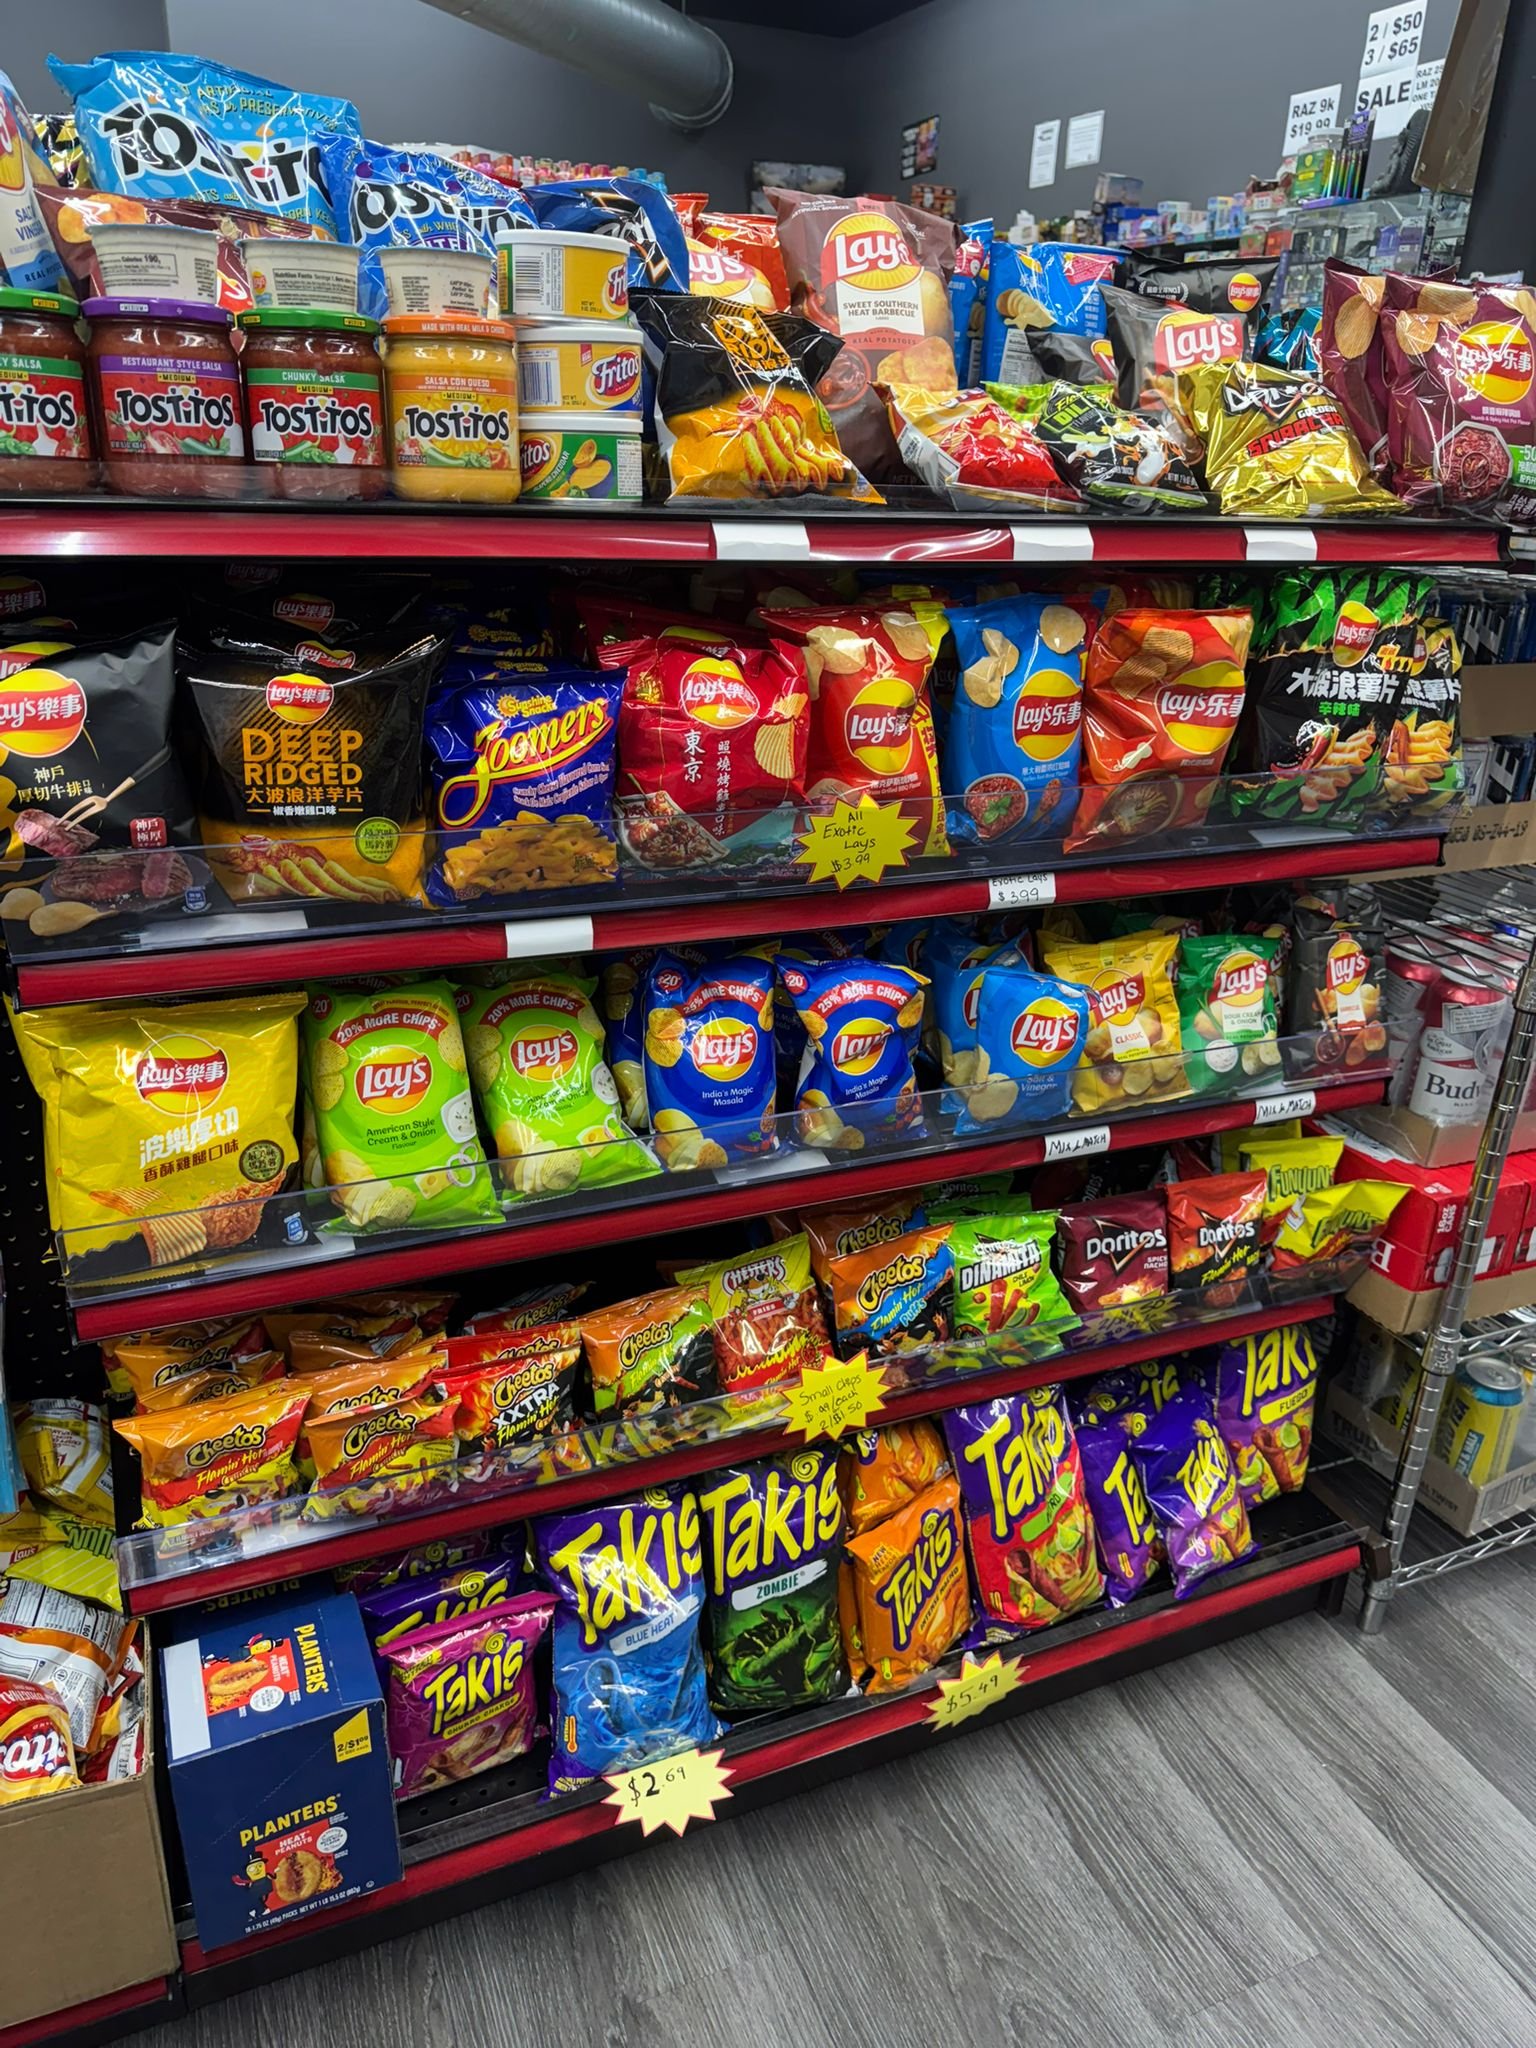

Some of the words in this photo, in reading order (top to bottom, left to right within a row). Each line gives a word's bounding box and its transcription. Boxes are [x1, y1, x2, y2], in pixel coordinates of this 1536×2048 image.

[1369, 24, 1379, 42] 2
[1392, 11, 1423, 36] $50
[1364, 49, 1374, 66] 3
[1387, 36, 1419, 61] $65
[1416, 68, 1433, 79] RAZ
[1357, 79, 1412, 113] SALE
[1412, 92, 1429, 103] ONE
[1292, 101, 1316, 119] RAZ
[1289, 117, 1331, 138] $1999
[834, 232, 913, 278] Lay's
[25, 269, 46, 282] REAL
[843, 300, 872, 310] SWEET
[874, 299, 919, 310] SOUTHERN
[848, 308, 870, 317] HEAT
[872, 307, 916, 318] BARBECUE
[1164, 318, 1242, 370] Lay's
[11, 356, 42, 370] SALSA
[122, 356, 174, 368] RESTAURANT
[176, 359, 201, 370] STYLE
[202, 361, 222, 372] SALSA
[591, 353, 639, 395] Fritos
[1501, 351, 1532, 373] 乐事
[161, 373, 194, 383] MEDIUM
[281, 371, 317, 383] CHUNKY
[319, 373, 346, 385] SALSA
[301, 386, 329, 394] MEDIUM
[425, 376, 449, 386] SALSA
[450, 377, 467, 386] CON
[468, 378, 490, 388] QUESO
[114, 385, 235, 428] TOSTITOS
[446, 392, 474, 400] MEDIUM
[260, 396, 373, 437] TOSTITOS
[405, 404, 510, 441] TOSTITOS
[1297, 404, 1337, 419] GOLDEN
[276, 600, 304, 620] Lay's
[304, 604, 332, 619] 樂事
[1336, 619, 1359, 646] Lay's
[269, 684, 302, 705] Lay's
[302, 687, 333, 704] 樂事
[685, 677, 724, 703] Lay's
[1285, 667, 1400, 704] 大波浪薯片
[37, 693, 83, 719] 樂事
[507, 694, 554, 713] Sunshine
[520, 702, 558, 719] Snacks
[1016, 703, 1051, 734] Lay's
[1050, 700, 1083, 727] 乐事
[1161, 691, 1206, 721] Lay's
[1206, 692, 1247, 718] 乐事
[1318, 701, 1361, 717] 辛辣味
[849, 711, 896, 744] Lay's
[241, 727, 364, 764] DEEP
[452, 697, 613, 798] Zoomers
[683, 729, 706, 784] 東京
[33, 765, 64, 783] 神戶
[243, 762, 364, 787] RIDGED
[17, 781, 83, 804] 厚切牛排
[246, 786, 365, 805] 大波浪洋芋片
[847, 811, 863, 823] All
[822, 823, 867, 839] Exotic
[843, 838, 876, 854] Lays
[1216, 960, 1268, 998] Lay's
[1330, 950, 1368, 985] Lay's
[727, 983, 761, 1003] CHIPS
[817, 990, 842, 1014] 25%
[841, 983, 875, 1002] MORE
[876, 984, 910, 1006] CHIPS
[1099, 978, 1140, 1019] Lay's
[487, 1001, 512, 1024] 20%
[509, 994, 541, 1009] MORE
[542, 995, 578, 1011] CHIPS
[336, 1021, 364, 1044] 20%
[364, 1012, 400, 1030] MORE
[402, 1013, 441, 1031] CHIPS
[1014, 1014, 1079, 1052] Lay's
[1115, 1031, 1145, 1045] CLASSIC
[516, 1033, 575, 1073] Lay's
[696, 1030, 755, 1067] Lay's
[138, 1063, 185, 1090] Lay's
[185, 1061, 226, 1085] 樂事
[361, 1057, 429, 1099] Lay's
[845, 1082, 868, 1097] India's
[867, 1074, 890, 1091] Magic
[1020, 1080, 1058, 1094] Vinegar
[1025, 1074, 1046, 1084] Salt
[702, 1088, 729, 1099] India's
[730, 1085, 755, 1100] Magic
[713, 1095, 744, 1106] Masala
[854, 1084, 881, 1100] Masala
[366, 1122, 410, 1138] American
[411, 1117, 435, 1133] Style
[367, 1132, 400, 1147] Cream
[400, 1131, 409, 1142] &
[409, 1126, 437, 1141] Onion
[391, 1139, 418, 1151] Flavour
[143, 1138, 240, 1184] 香酥雞腿口味
[1086, 1227, 1167, 1262] Doritos
[1199, 1221, 1256, 1248] Doritos
[959, 1239, 1043, 1292] DINAMITA
[1147, 1254, 1168, 1263] SPICY
[1231, 1244, 1251, 1263] Hot
[722, 1255, 786, 1297] CHESTER'S
[858, 1253, 927, 1315] Cheetos
[903, 1281, 923, 1303] Hot
[752, 1303, 777, 1317] FRIES
[899, 1299, 927, 1328] Puffs
[619, 1319, 672, 1371] Cheetos
[491, 1361, 557, 1410] Cheetos
[799, 1384, 834, 1407] Small
[493, 1382, 560, 1431] XXTRA
[1278, 1388, 1309, 1414] FUEGO
[343, 1411, 418, 1458] Cheetos
[496, 1411, 537, 1447] Flamin'
[538, 1396, 559, 1418] Hot
[186, 1424, 266, 1467] Cheetos
[350, 1444, 390, 1480] Flamin'
[389, 1431, 413, 1455] Hot
[196, 1457, 240, 1488] Flamin'
[241, 1445, 265, 1467] Hot
[700, 1461, 841, 1597] Takis
[550, 1492, 703, 1648] Takis
[882, 1515, 952, 1646] Takis
[939, 1566, 960, 1595] NACHO
[755, 1573, 800, 1600] ZOMBIE
[624, 1627, 649, 1647] BLUE
[650, 1612, 676, 1637] HEAT
[269, 1654, 282, 1683] PEANUTS
[278, 1655, 290, 1677] HEAT
[293, 1622, 329, 1694] PLANTERS
[424, 1640, 524, 1734] Takis
[945, 1674, 1000, 1715] $5.49
[447, 1714, 482, 1736] CHURRO
[627, 1766, 688, 1808] $2.69
[240, 1795, 338, 1848] PLANTERS
[275, 1836, 313, 1856] PEANUTS
[279, 1831, 307, 1848] HEAT
[299, 1904, 309, 1914] NET
[309, 1901, 318, 1911] WT
